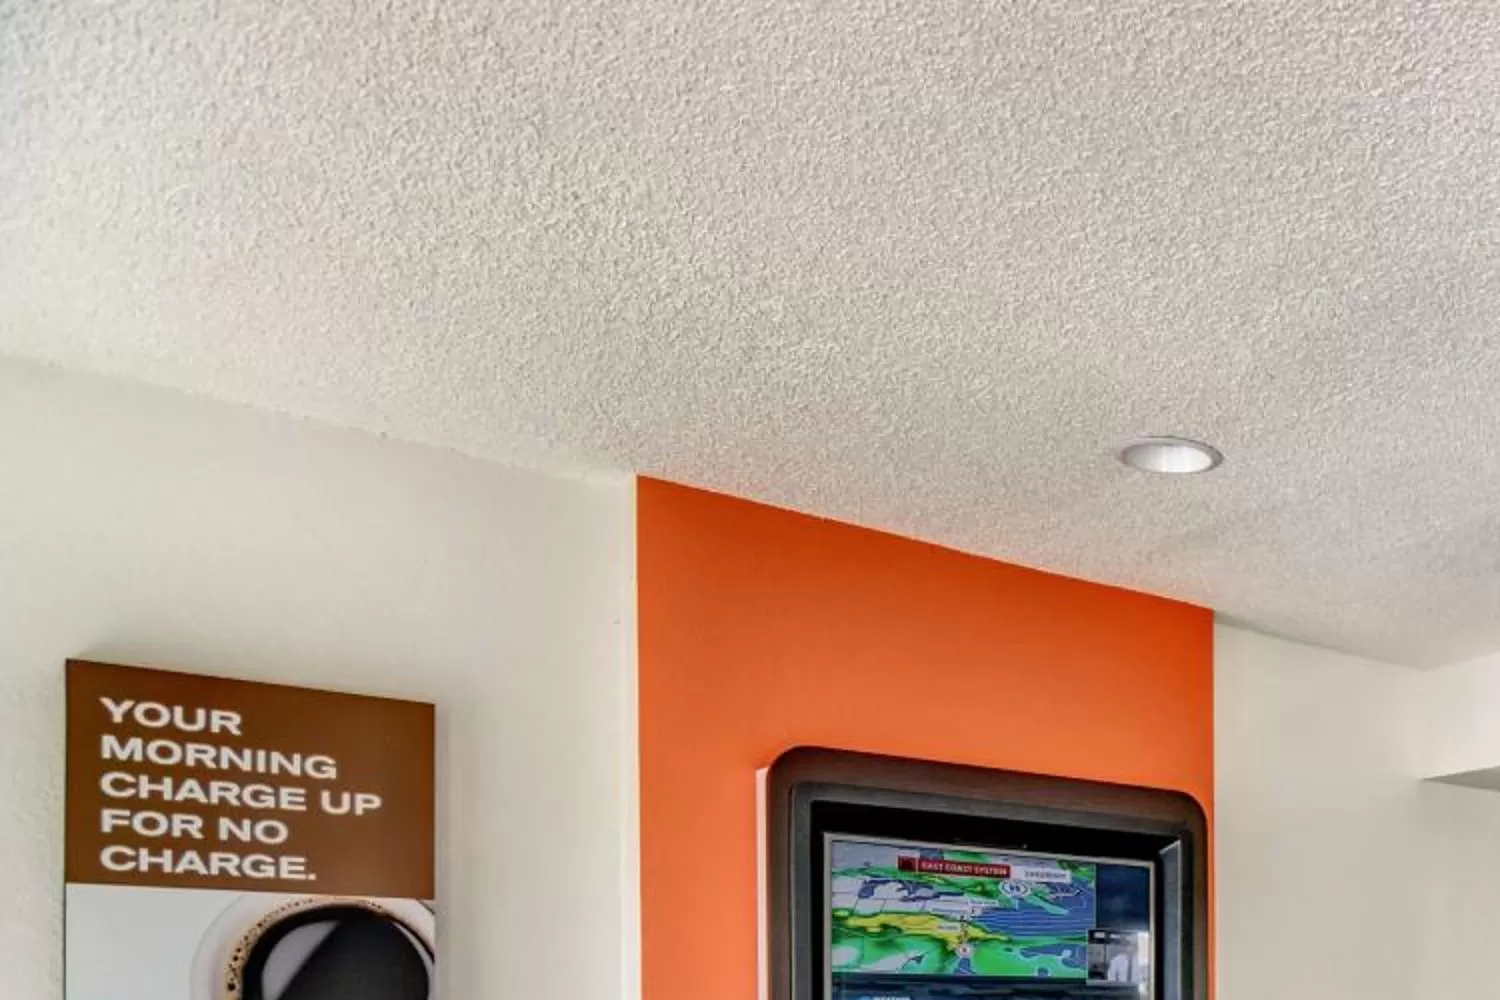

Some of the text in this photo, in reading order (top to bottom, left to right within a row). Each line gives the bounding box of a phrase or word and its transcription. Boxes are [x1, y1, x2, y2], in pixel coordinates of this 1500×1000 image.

[100, 697, 242, 736] YOUR
[101, 735, 338, 779] MORNING
[100, 771, 382, 816] CHARGE UP
[101, 808, 289, 844] FOR NO
[100, 845, 318, 881] CHARGE.
